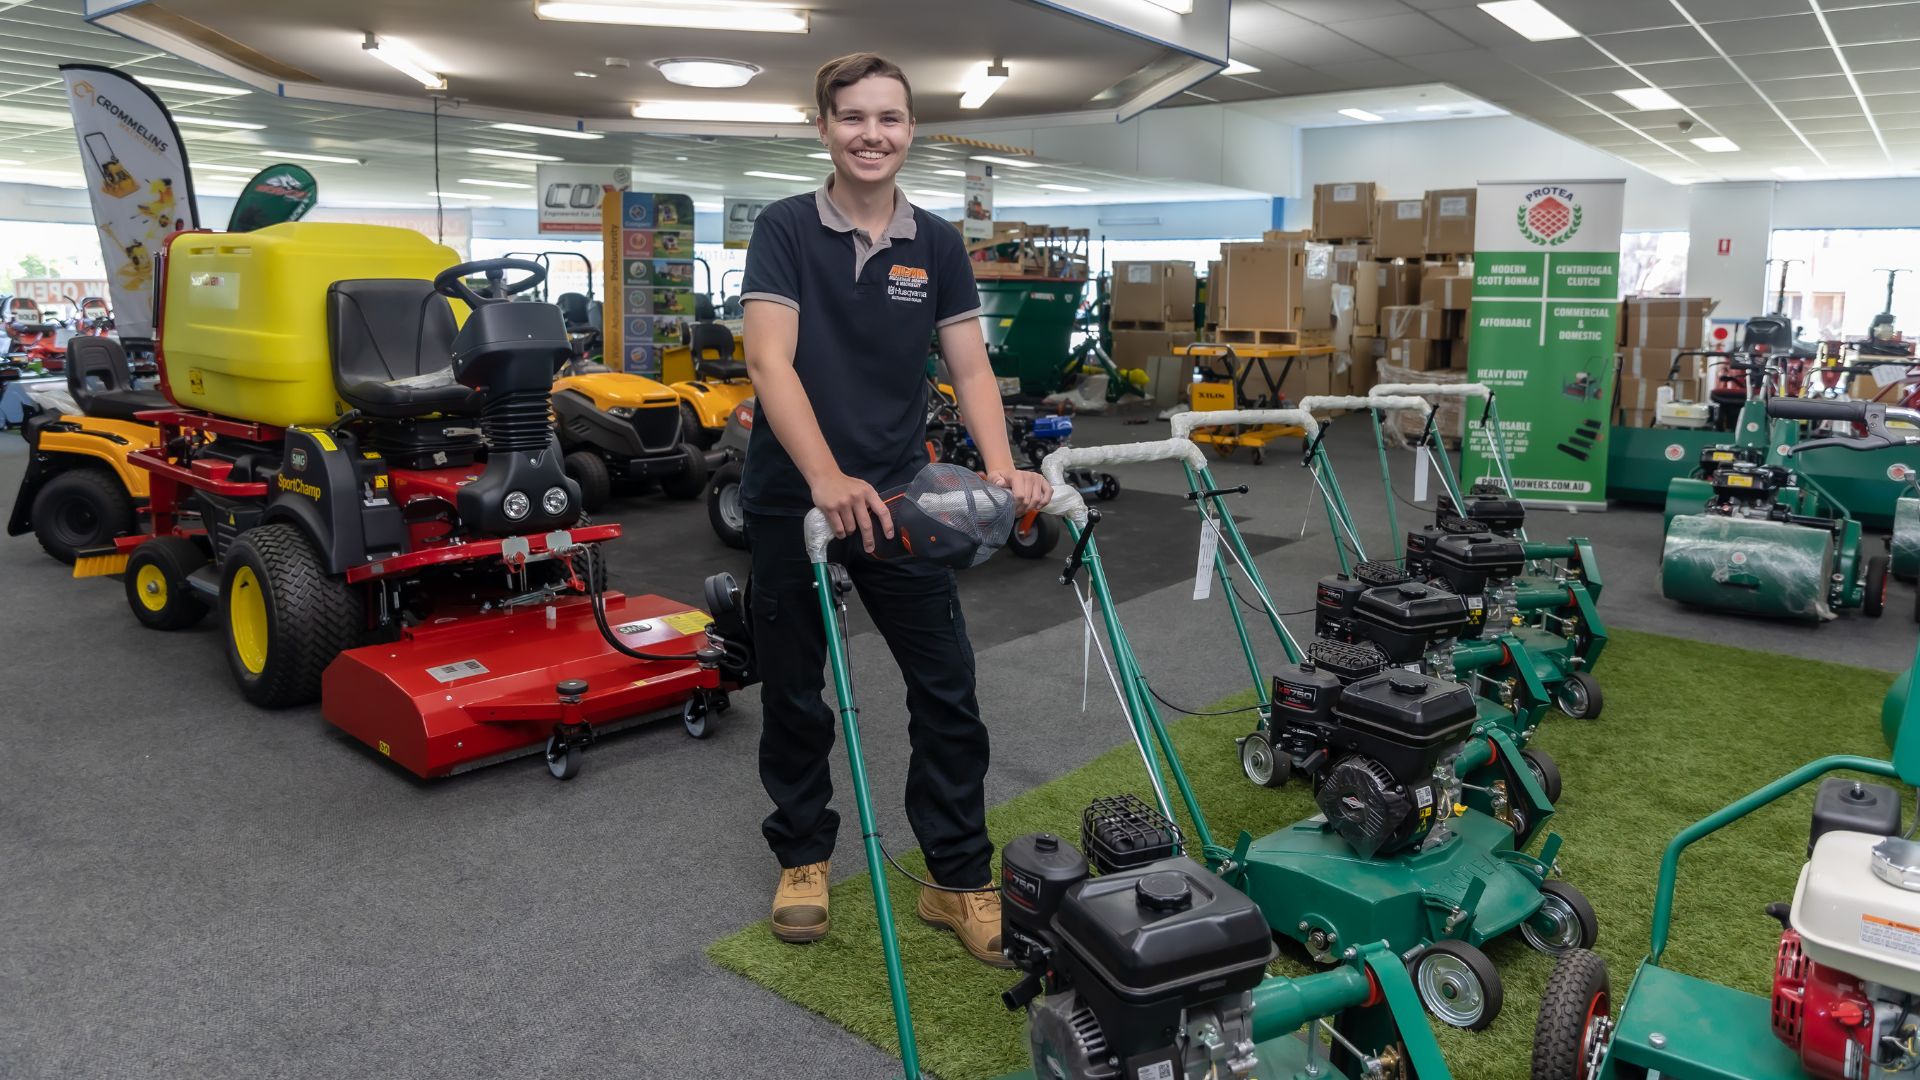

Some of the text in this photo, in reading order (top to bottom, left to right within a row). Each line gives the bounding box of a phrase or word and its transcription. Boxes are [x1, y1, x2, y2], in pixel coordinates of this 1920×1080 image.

[97, 95, 169, 152] CROMMELINS
[1525, 186, 1574, 202] PROTEA
[610, 224, 619, 281] Productivity
[1491, 264, 1527, 274] MODERN
[1556, 265, 1613, 275] CENTRIFUGAL
[1477, 276, 1540, 286] SCOTT BONNAR
[1567, 277, 1600, 286] CLUTCH
[1554, 307, 1609, 317] COMMERCIAL
[1480, 318, 1532, 328] AFFORDABLE
[1578, 320, 1584, 328] &
[1559, 331, 1602, 340] DOMESTIC
[1477, 369, 1528, 379] HEAVY DUTY
[1468, 420, 1532, 431] CUTOISABLE
[278, 471, 321, 501] SportChamp
[1482, 478, 1584, 491] PROTEMOWERS.COM.AU
